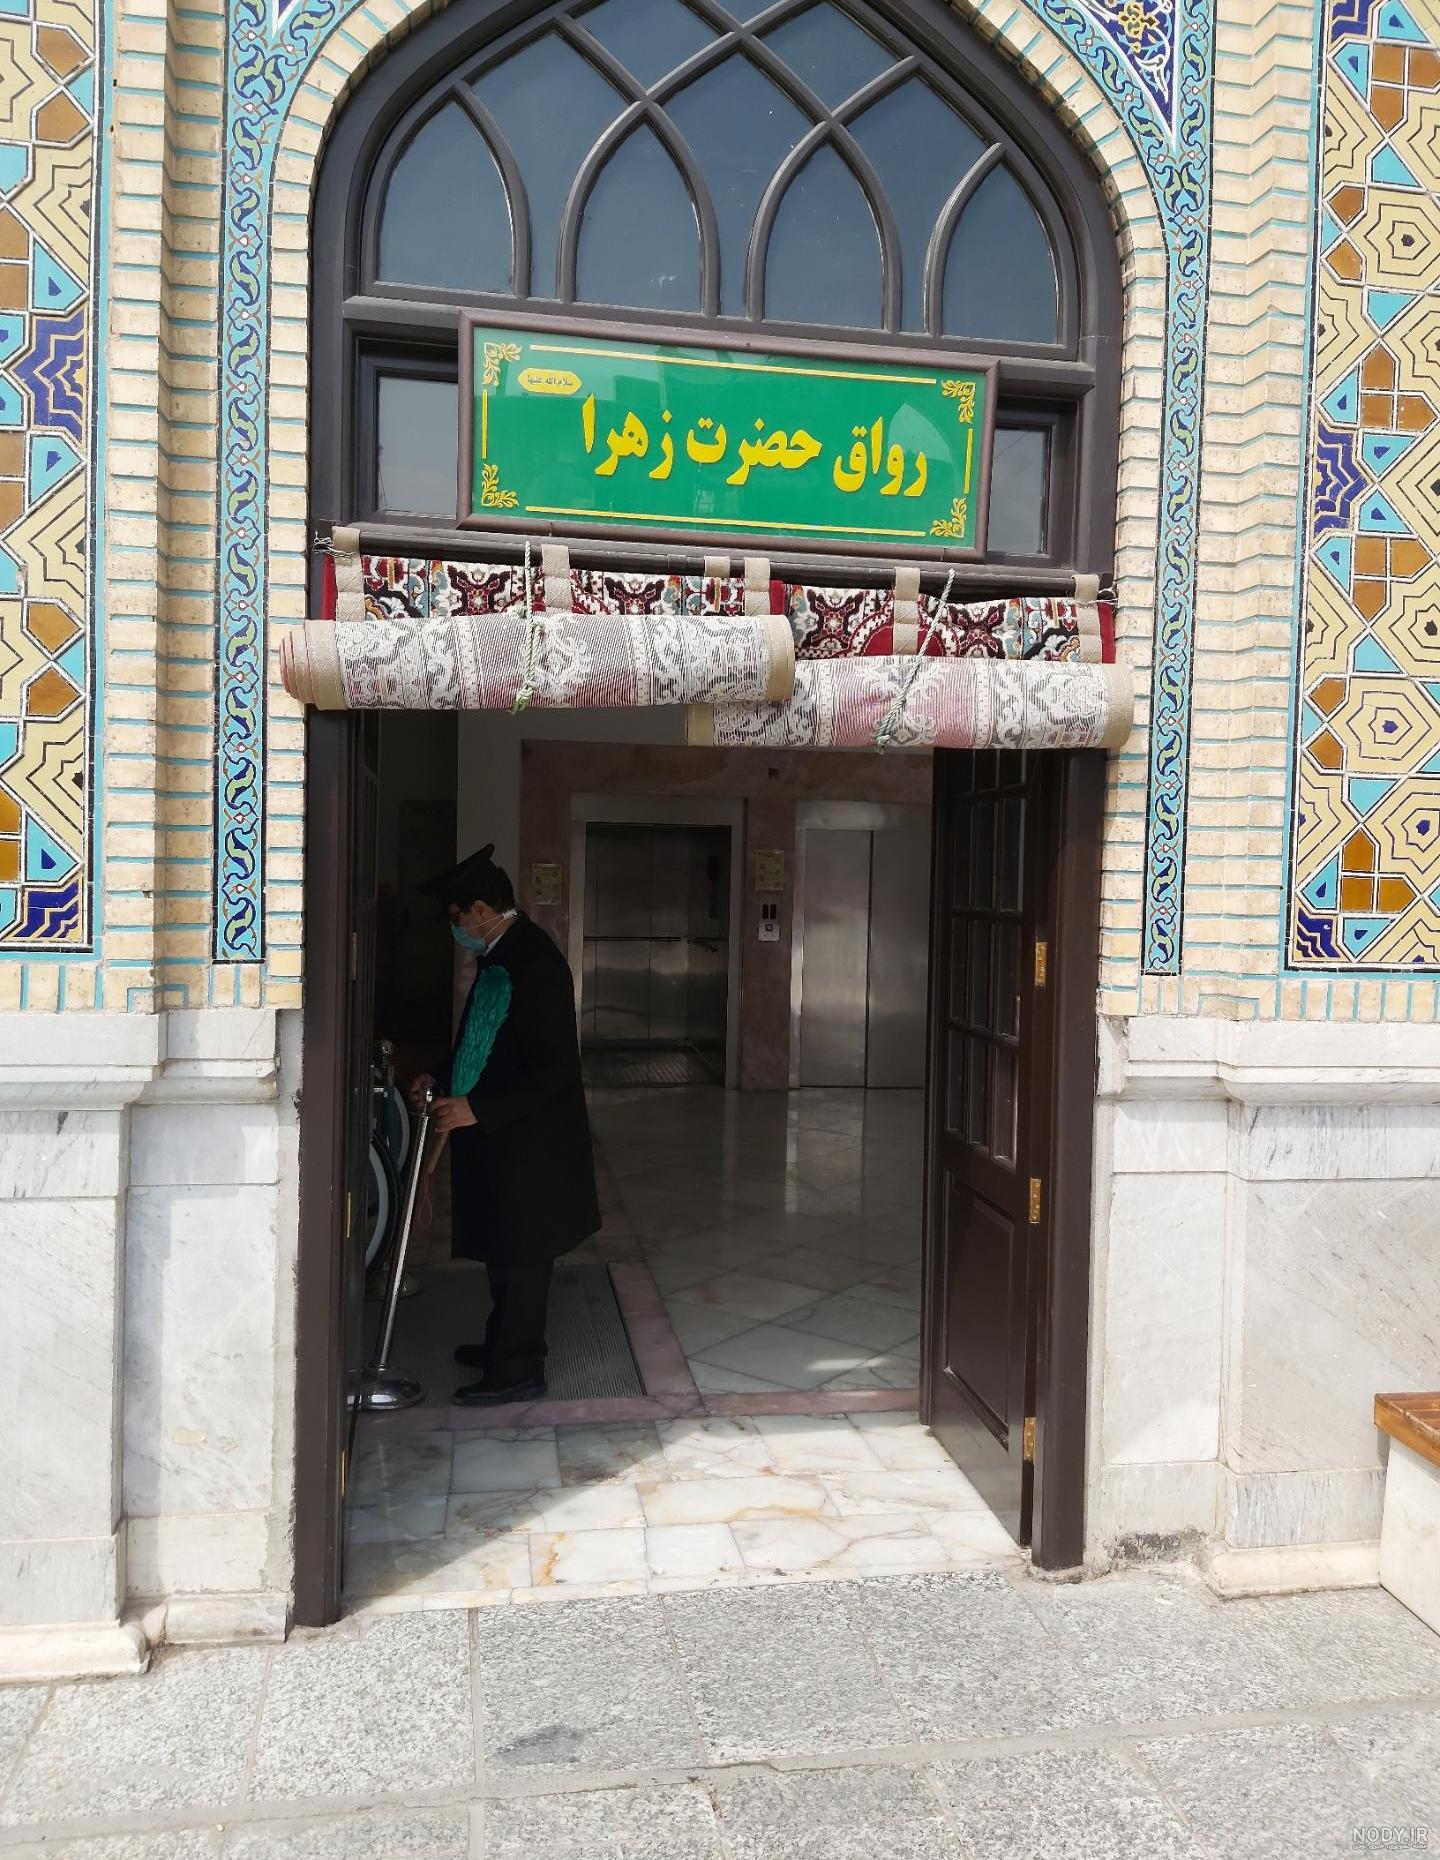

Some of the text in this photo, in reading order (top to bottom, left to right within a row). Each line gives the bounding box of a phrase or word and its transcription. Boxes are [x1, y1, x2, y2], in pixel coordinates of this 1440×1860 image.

[581, 393, 927, 497] رواق حضرت زهرا
